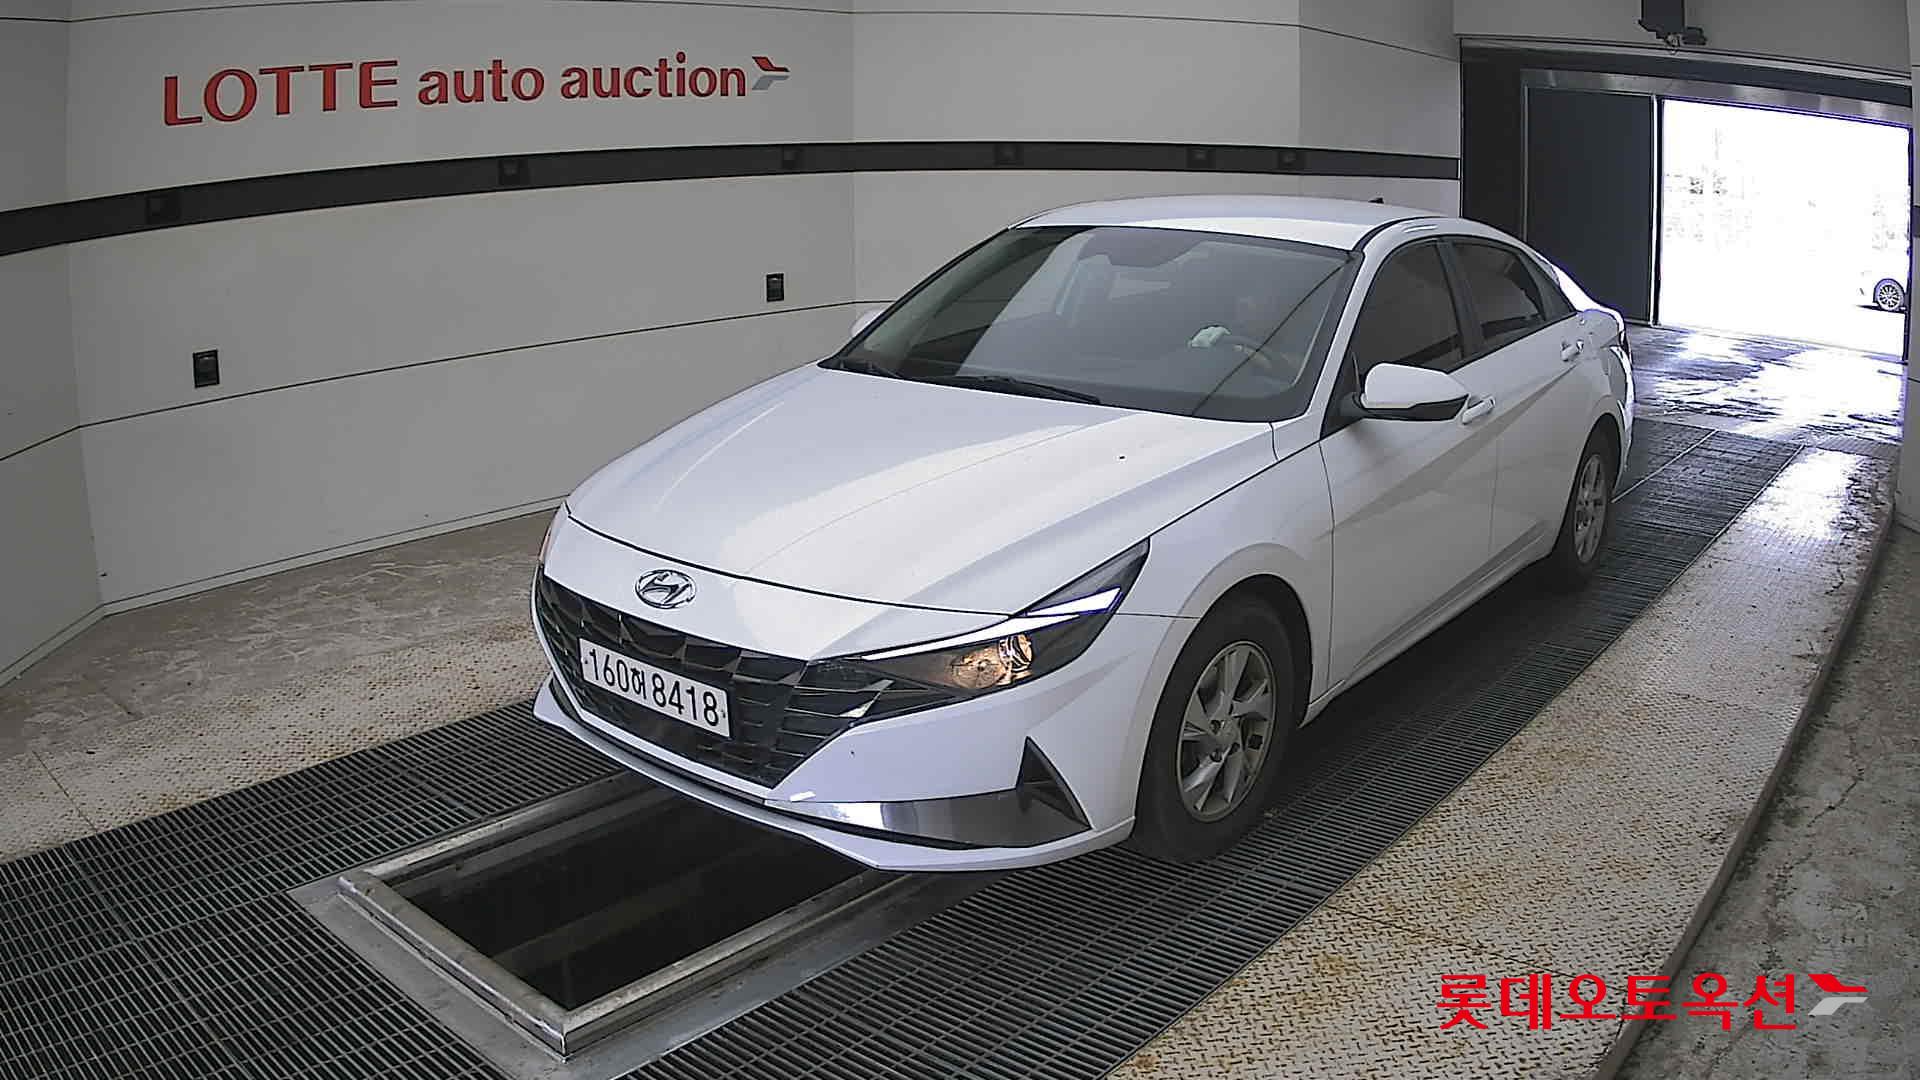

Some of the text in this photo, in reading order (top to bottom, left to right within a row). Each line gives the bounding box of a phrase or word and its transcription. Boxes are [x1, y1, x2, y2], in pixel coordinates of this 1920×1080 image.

[164, 51, 747, 126] LOTTE auto auction
